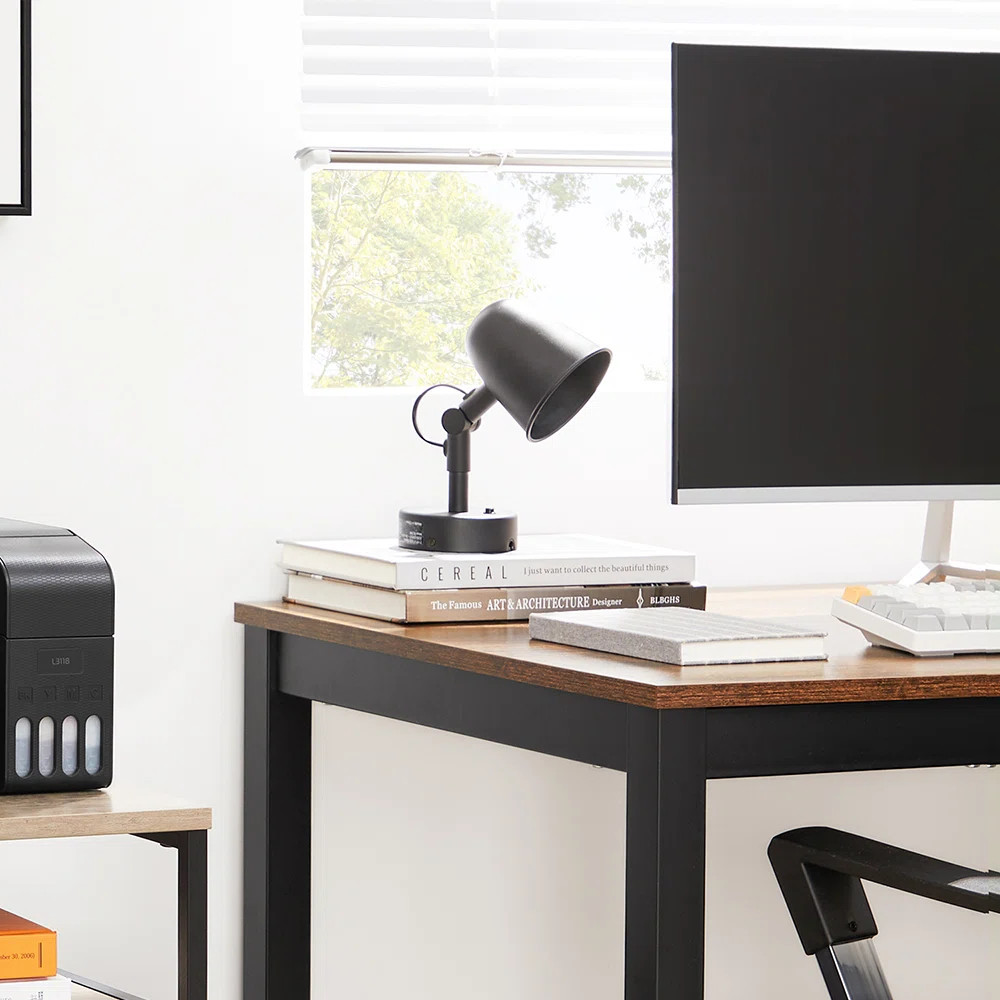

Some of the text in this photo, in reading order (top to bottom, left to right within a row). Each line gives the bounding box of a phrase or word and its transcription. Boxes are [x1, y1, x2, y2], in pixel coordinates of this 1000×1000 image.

[421, 566, 507, 582] CEREAL
[527, 567, 543, 576] just
[573, 565, 597, 573] collect
[598, 564, 611, 573] the
[612, 563, 645, 572] beautiful
[646, 563, 669, 573] things
[431, 596, 680, 611] The Famous ART & ARCHITECTURE Designer BLBGHS
[52, 657, 70, 665] L3118
